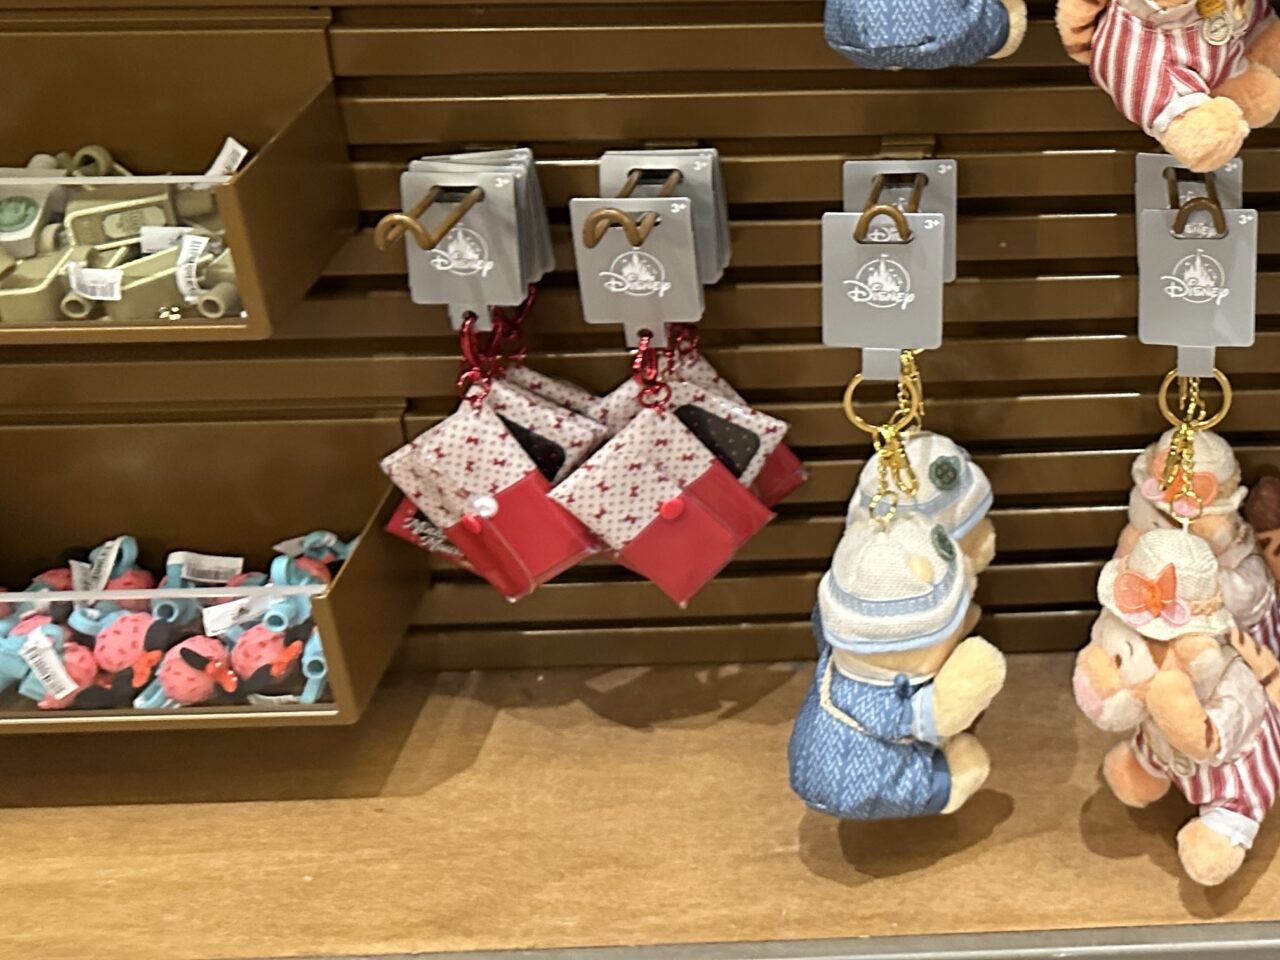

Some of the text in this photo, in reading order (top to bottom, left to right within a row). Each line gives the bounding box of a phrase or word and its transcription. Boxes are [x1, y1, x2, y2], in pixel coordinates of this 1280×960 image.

[938, 163, 953, 174] 3+
[670, 202, 688, 214] 3+
[924, 218, 941, 230] 3+
[1238, 213, 1255, 225] 3+
[426, 248, 494, 277] Disney
[598, 271, 672, 298] Disney
[1160, 275, 1230, 306] Disney
[842, 279, 916, 310] Disney
